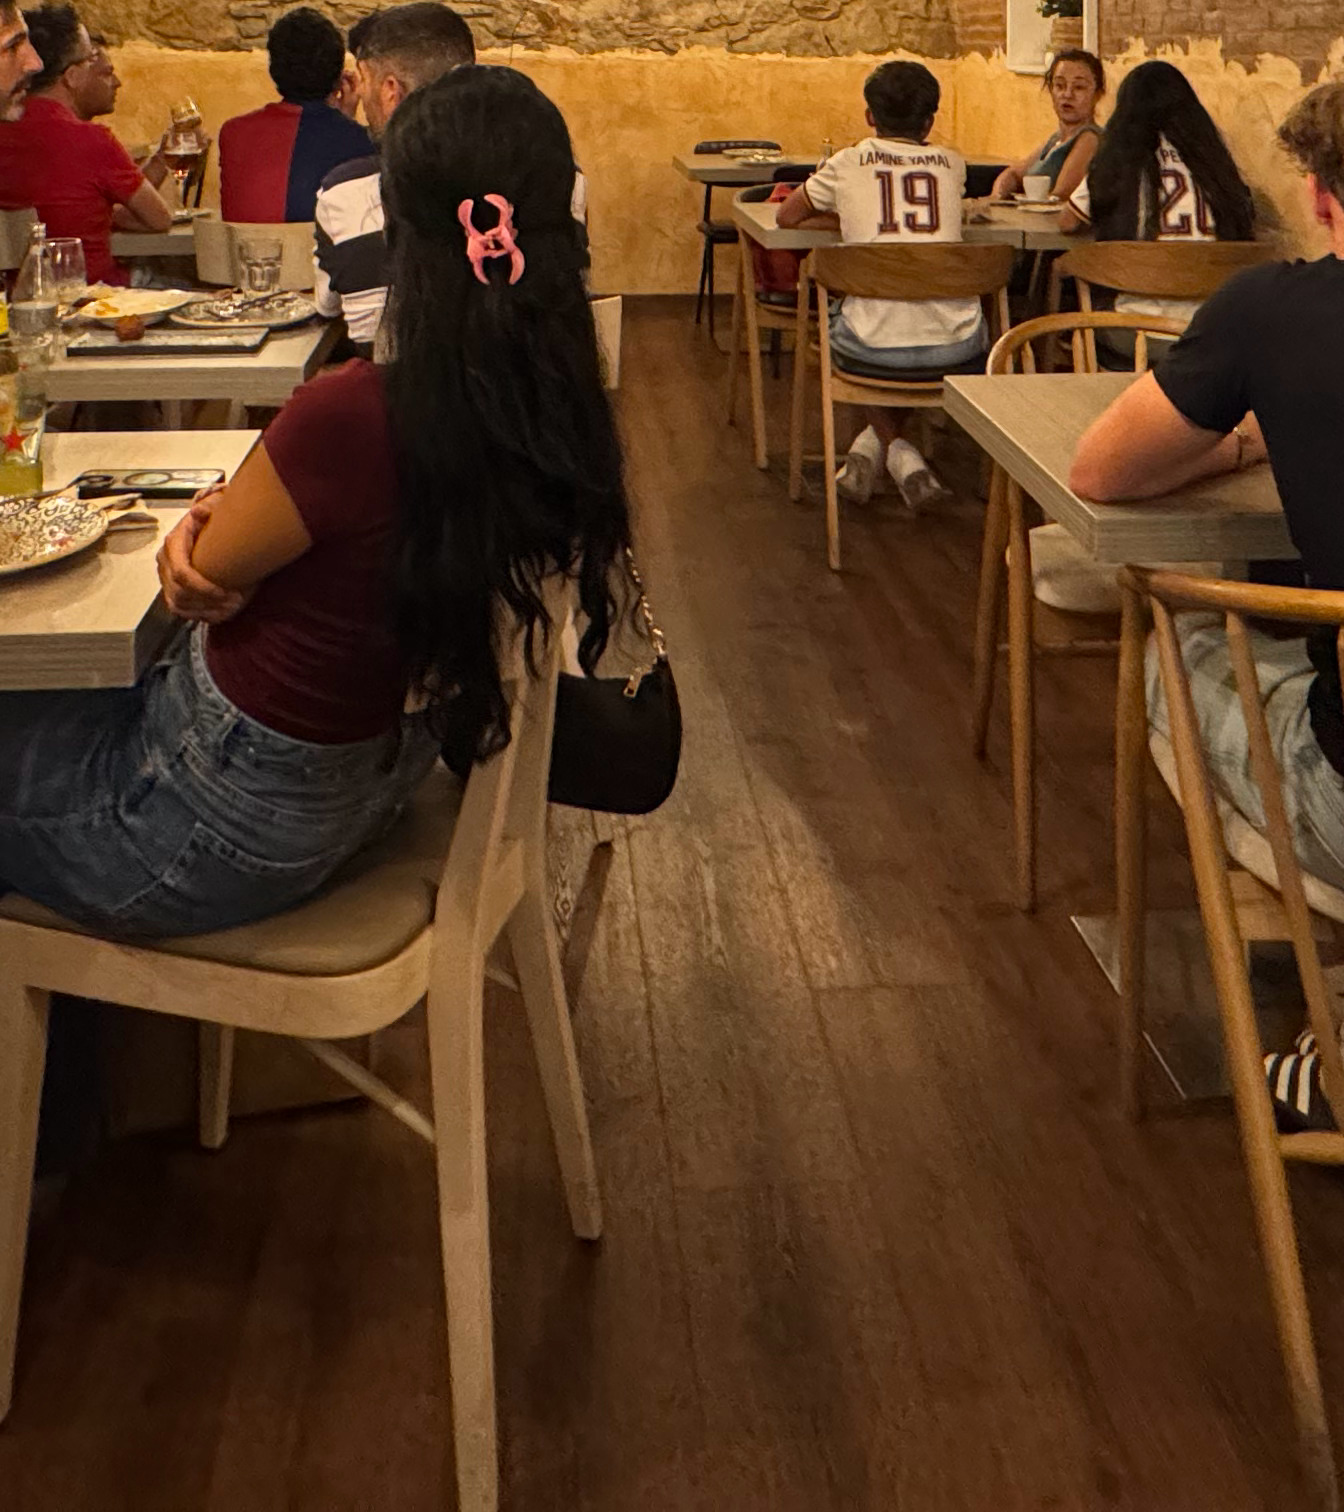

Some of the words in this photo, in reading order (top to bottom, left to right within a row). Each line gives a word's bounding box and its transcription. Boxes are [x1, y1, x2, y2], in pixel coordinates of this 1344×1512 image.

[859, 151, 904, 167] LAMINE
[908, 153, 951, 169] YAMAL
[874, 169, 941, 235] 19
